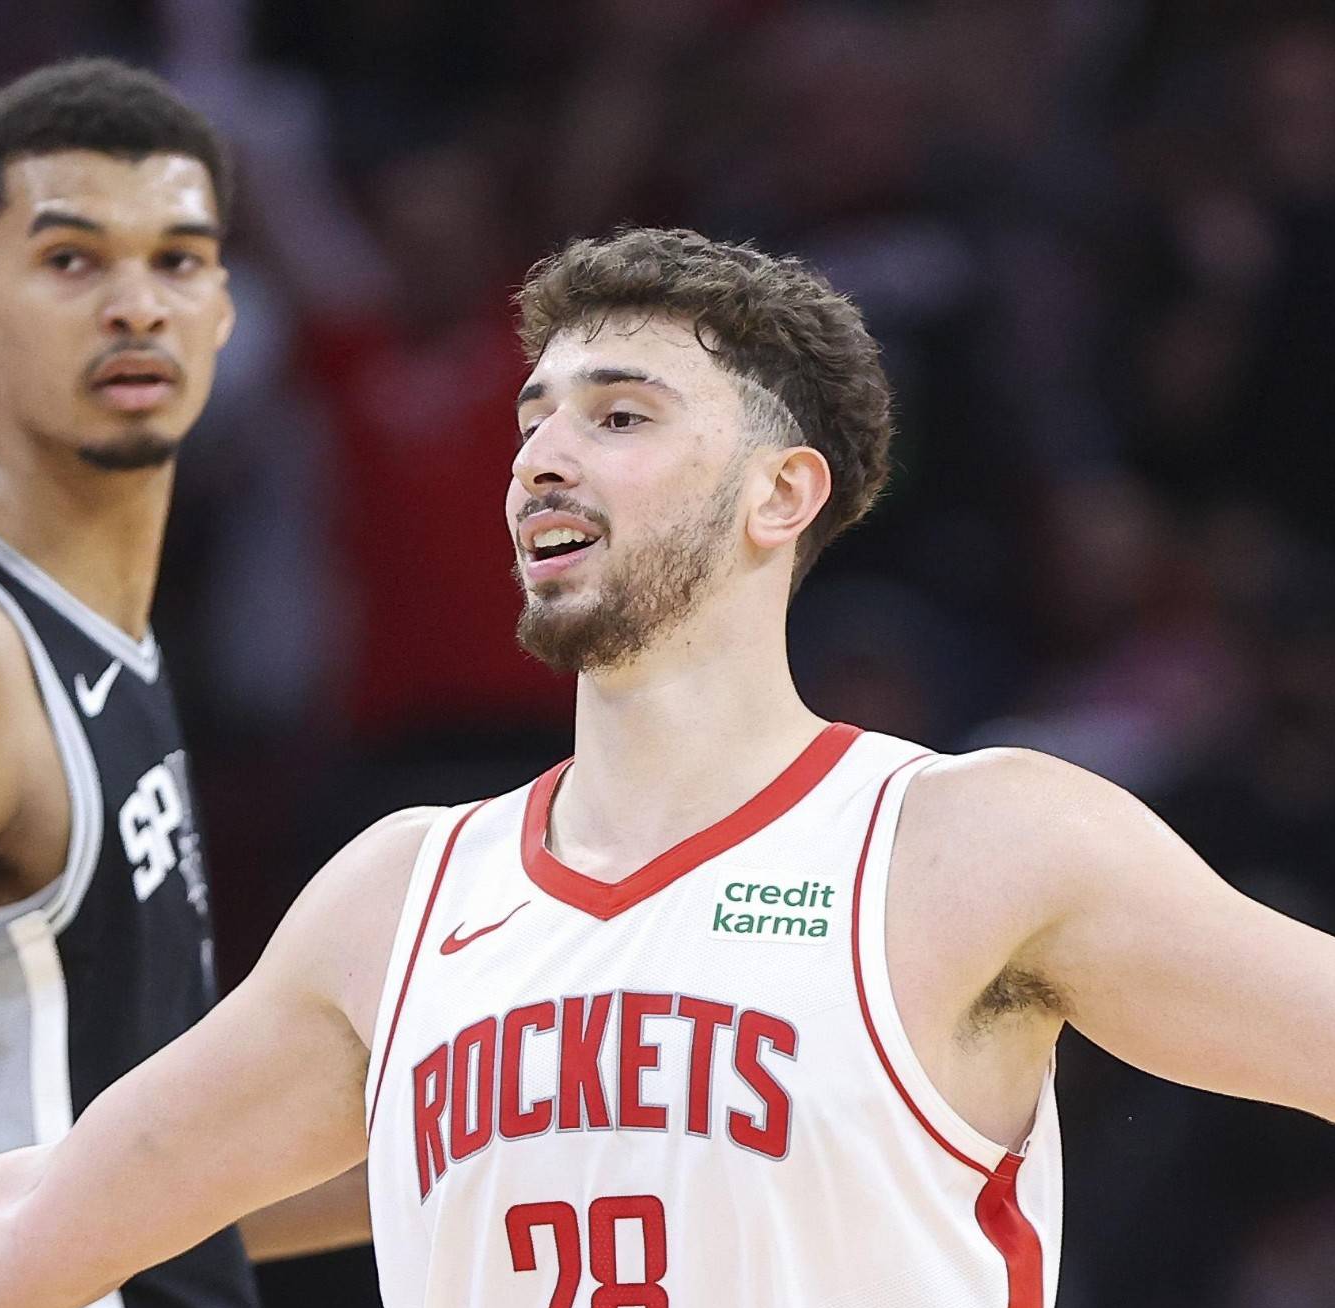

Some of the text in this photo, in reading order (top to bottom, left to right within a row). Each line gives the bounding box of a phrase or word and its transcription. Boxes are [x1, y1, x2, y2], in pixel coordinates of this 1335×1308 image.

[724, 880, 835, 908] credit
[712, 903, 829, 938] karma
[411, 988, 800, 1206] ROCKETS
